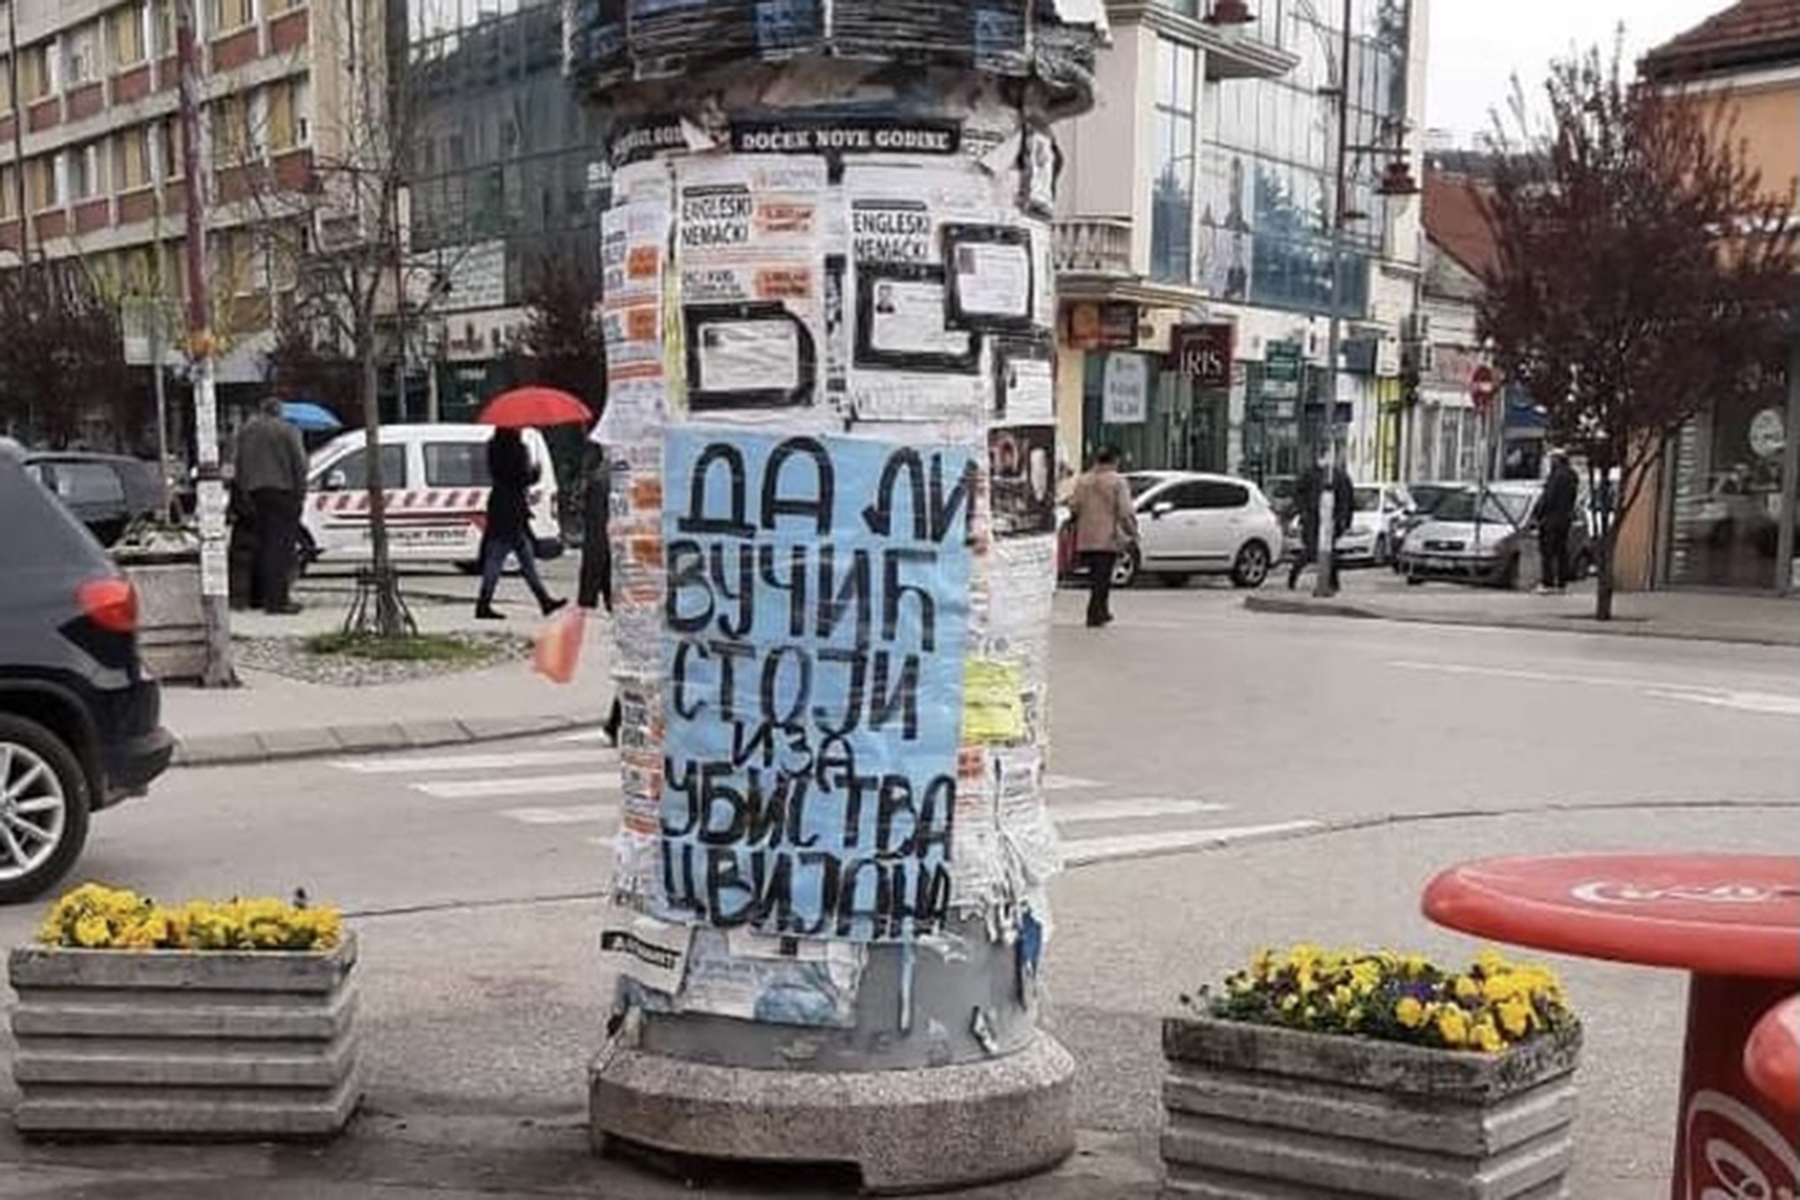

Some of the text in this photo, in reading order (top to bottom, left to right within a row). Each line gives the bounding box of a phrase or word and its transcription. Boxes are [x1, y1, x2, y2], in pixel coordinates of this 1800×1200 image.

[742, 127, 810, 149] DOČEK
[815, 129, 870, 147] NOVE
[875, 129, 949, 149] GODINE
[682, 197, 752, 221] ENGLESKI
[853, 212, 931, 234] ENGLESKI
[682, 221, 748, 246] NEMAČKI
[854, 237, 929, 260] NEMAČKI
[1181, 348, 1222, 376] IRIS
[678, 436, 835, 539] ДА
[862, 446, 980, 546] ЛИ
[666, 539, 938, 653] ВУЧИЋ
[674, 638, 920, 741] СТОЈИ
[733, 720, 856, 793] ИЗА
[661, 756, 956, 862] УБИСТВА
